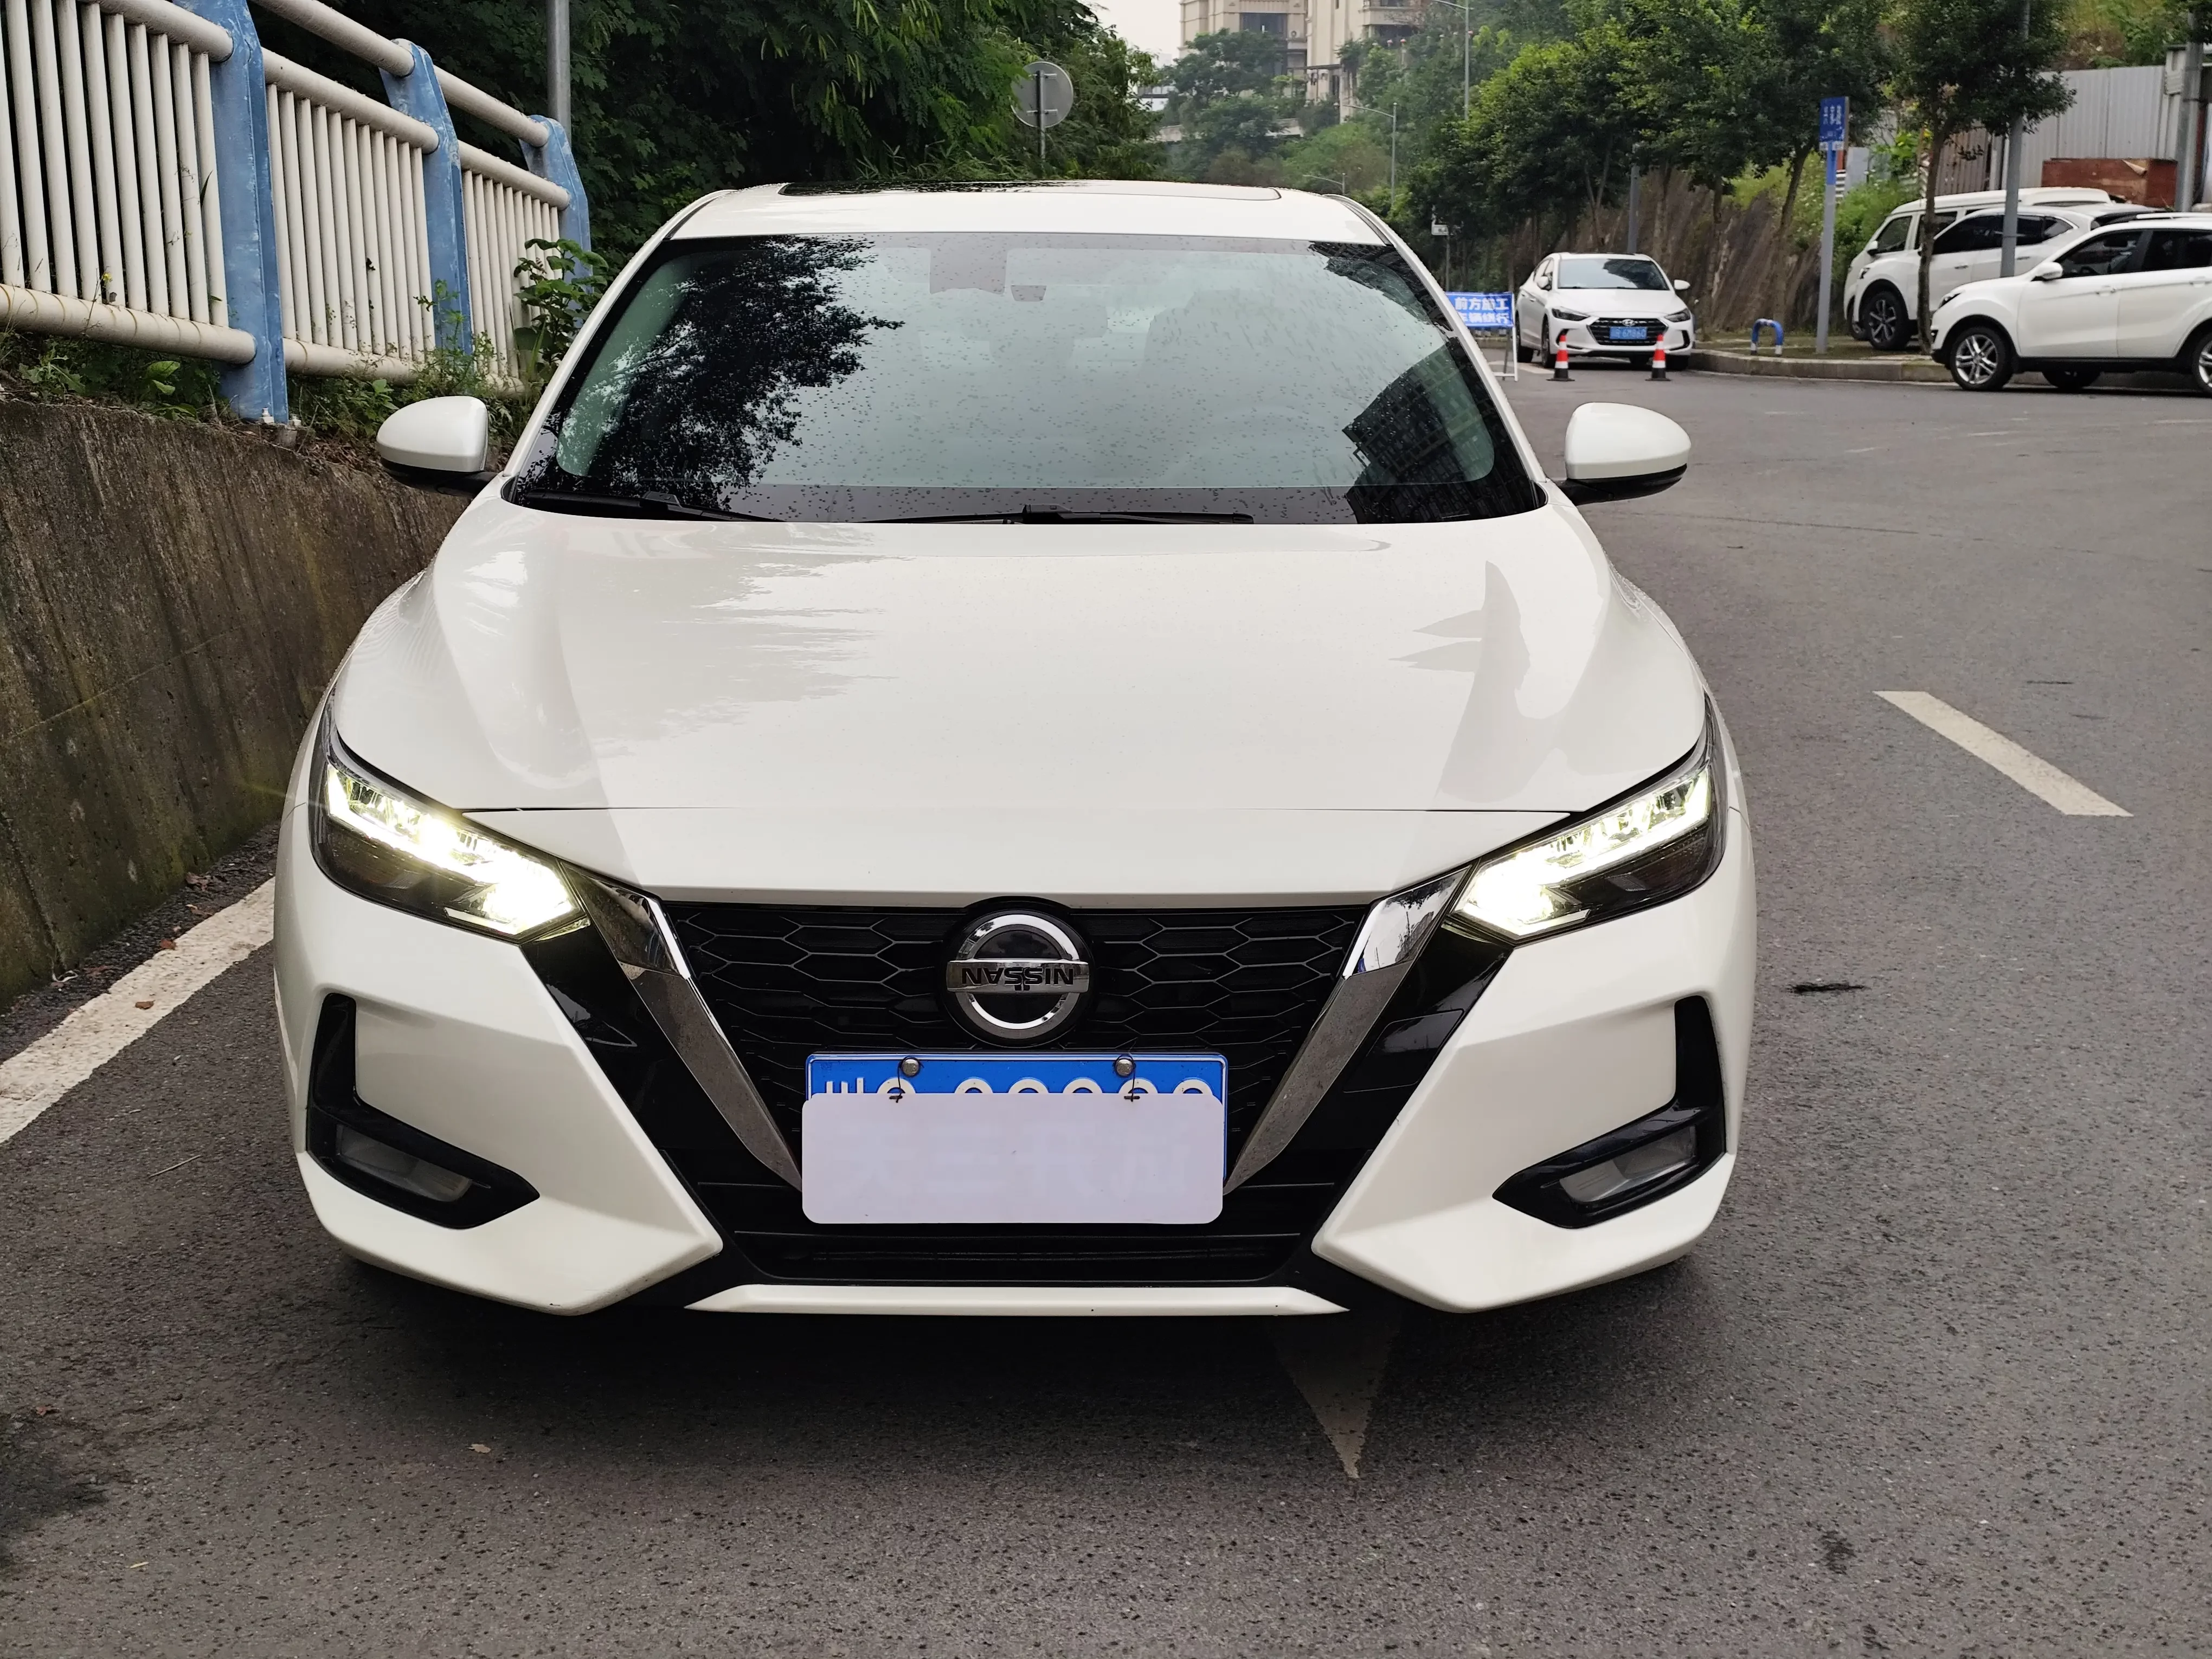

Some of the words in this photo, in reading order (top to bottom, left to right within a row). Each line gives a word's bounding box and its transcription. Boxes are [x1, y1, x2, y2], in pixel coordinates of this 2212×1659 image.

[1455, 297, 1509, 311] 前方施工
[961, 967, 1073, 986] NISSAN
